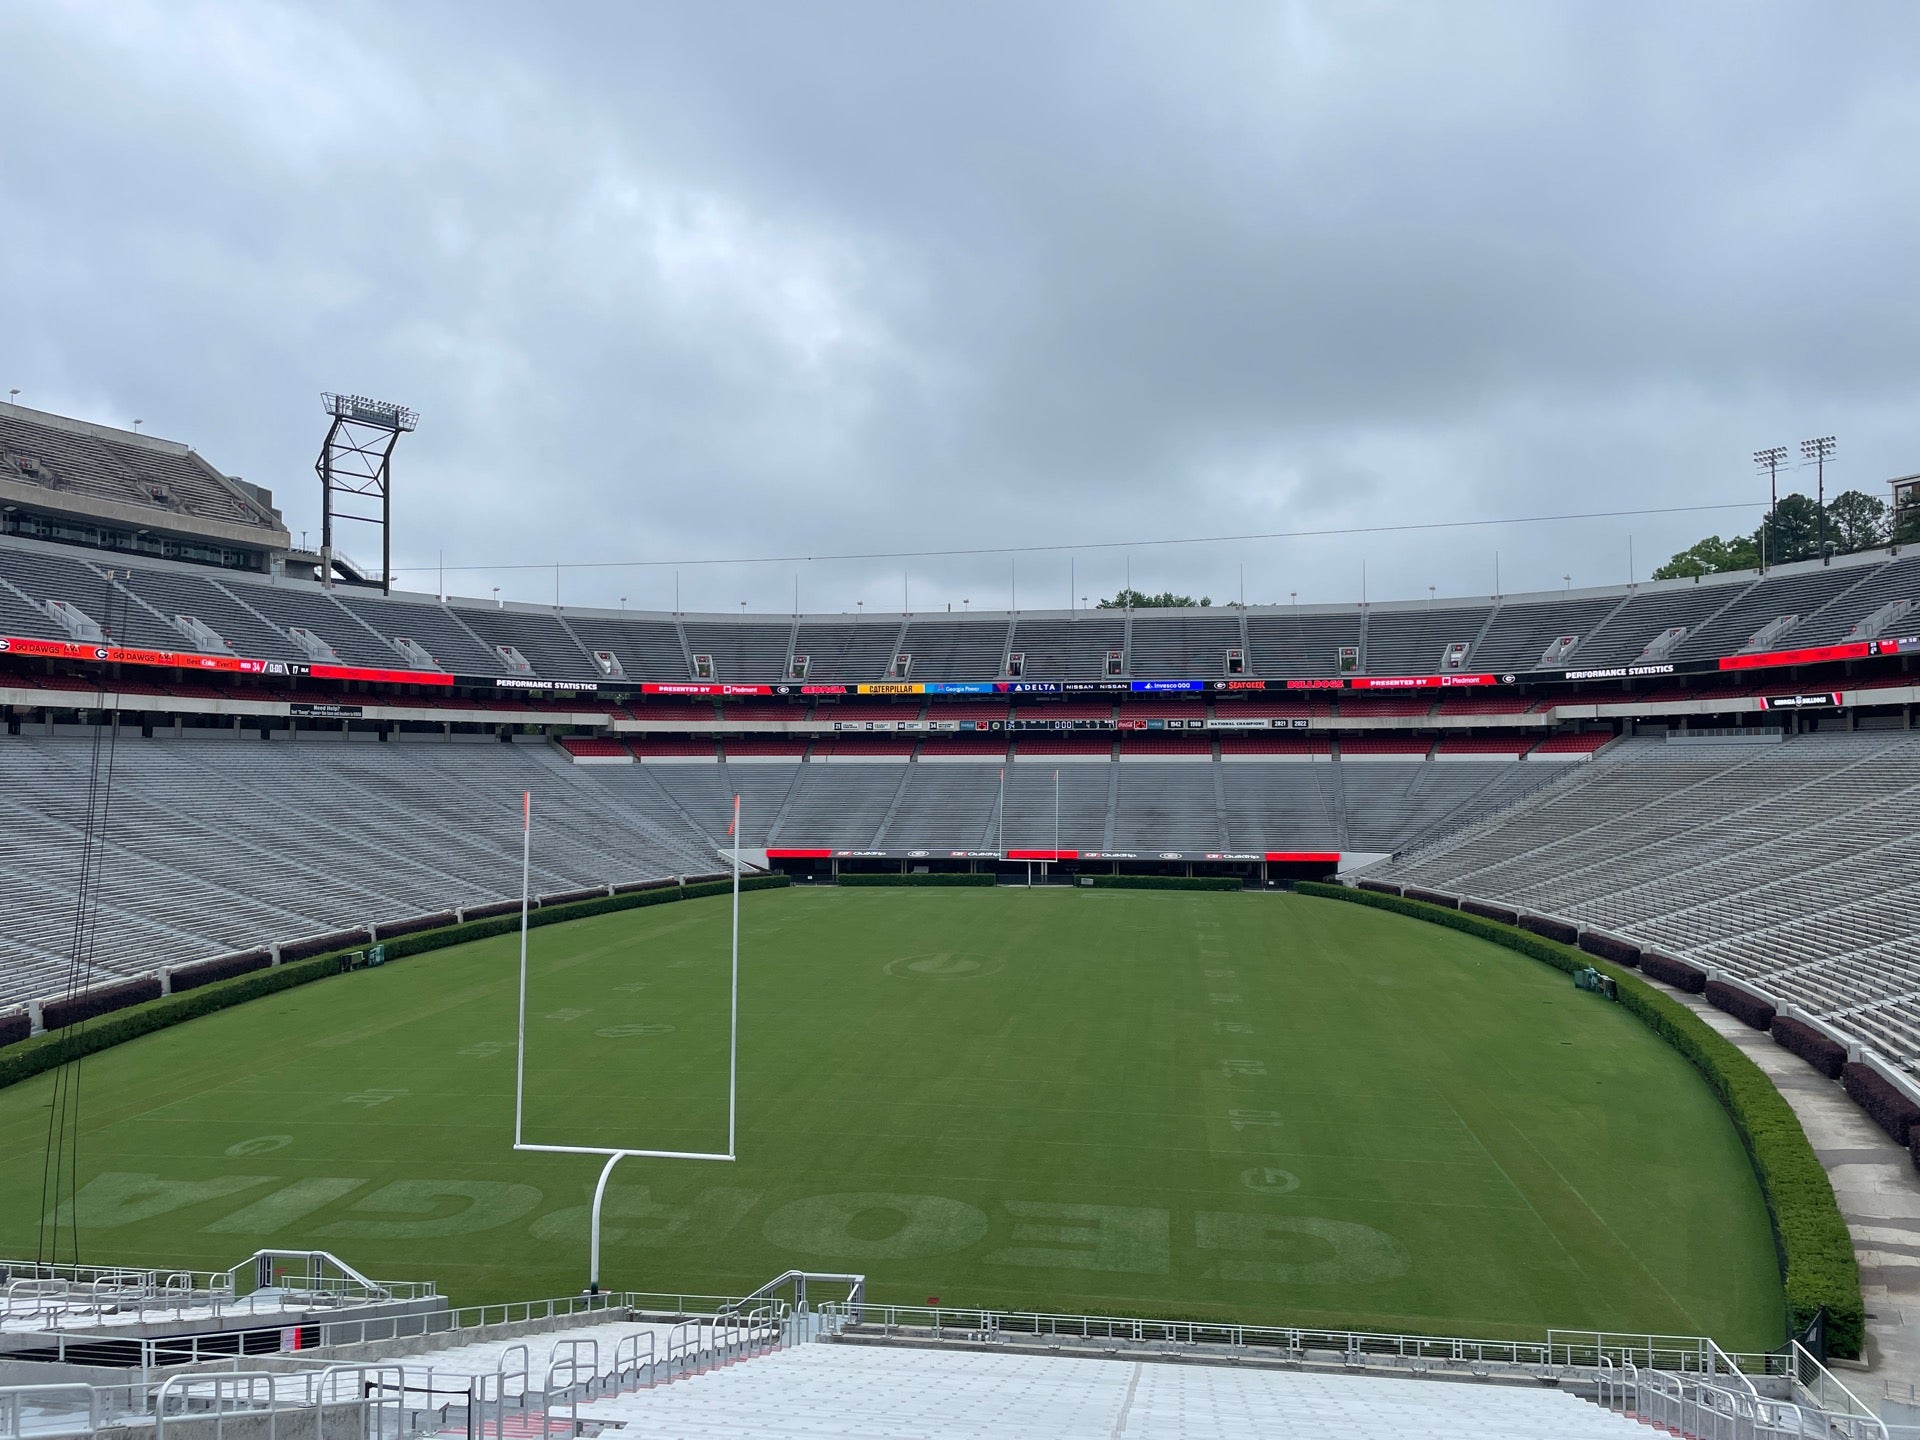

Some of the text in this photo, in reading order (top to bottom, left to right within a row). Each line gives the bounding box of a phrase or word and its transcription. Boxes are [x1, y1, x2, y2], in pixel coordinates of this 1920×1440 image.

[30, 645, 60, 654] DAWGS
[126, 654, 154, 662] DAWGS
[252, 662, 260, 672] 34
[270, 664, 282, 673] 0:00
[1566, 664, 1674, 680] PERFORMANCE STATISTICS
[496, 680, 552, 688] PERFORMANCE
[1228, 681, 1266, 690] SEATGEEK
[1286, 680, 1344, 689] BULLDOGS
[800, 686, 848, 694] GEORGIA
[869, 685, 913, 693] CATERPILLAR
